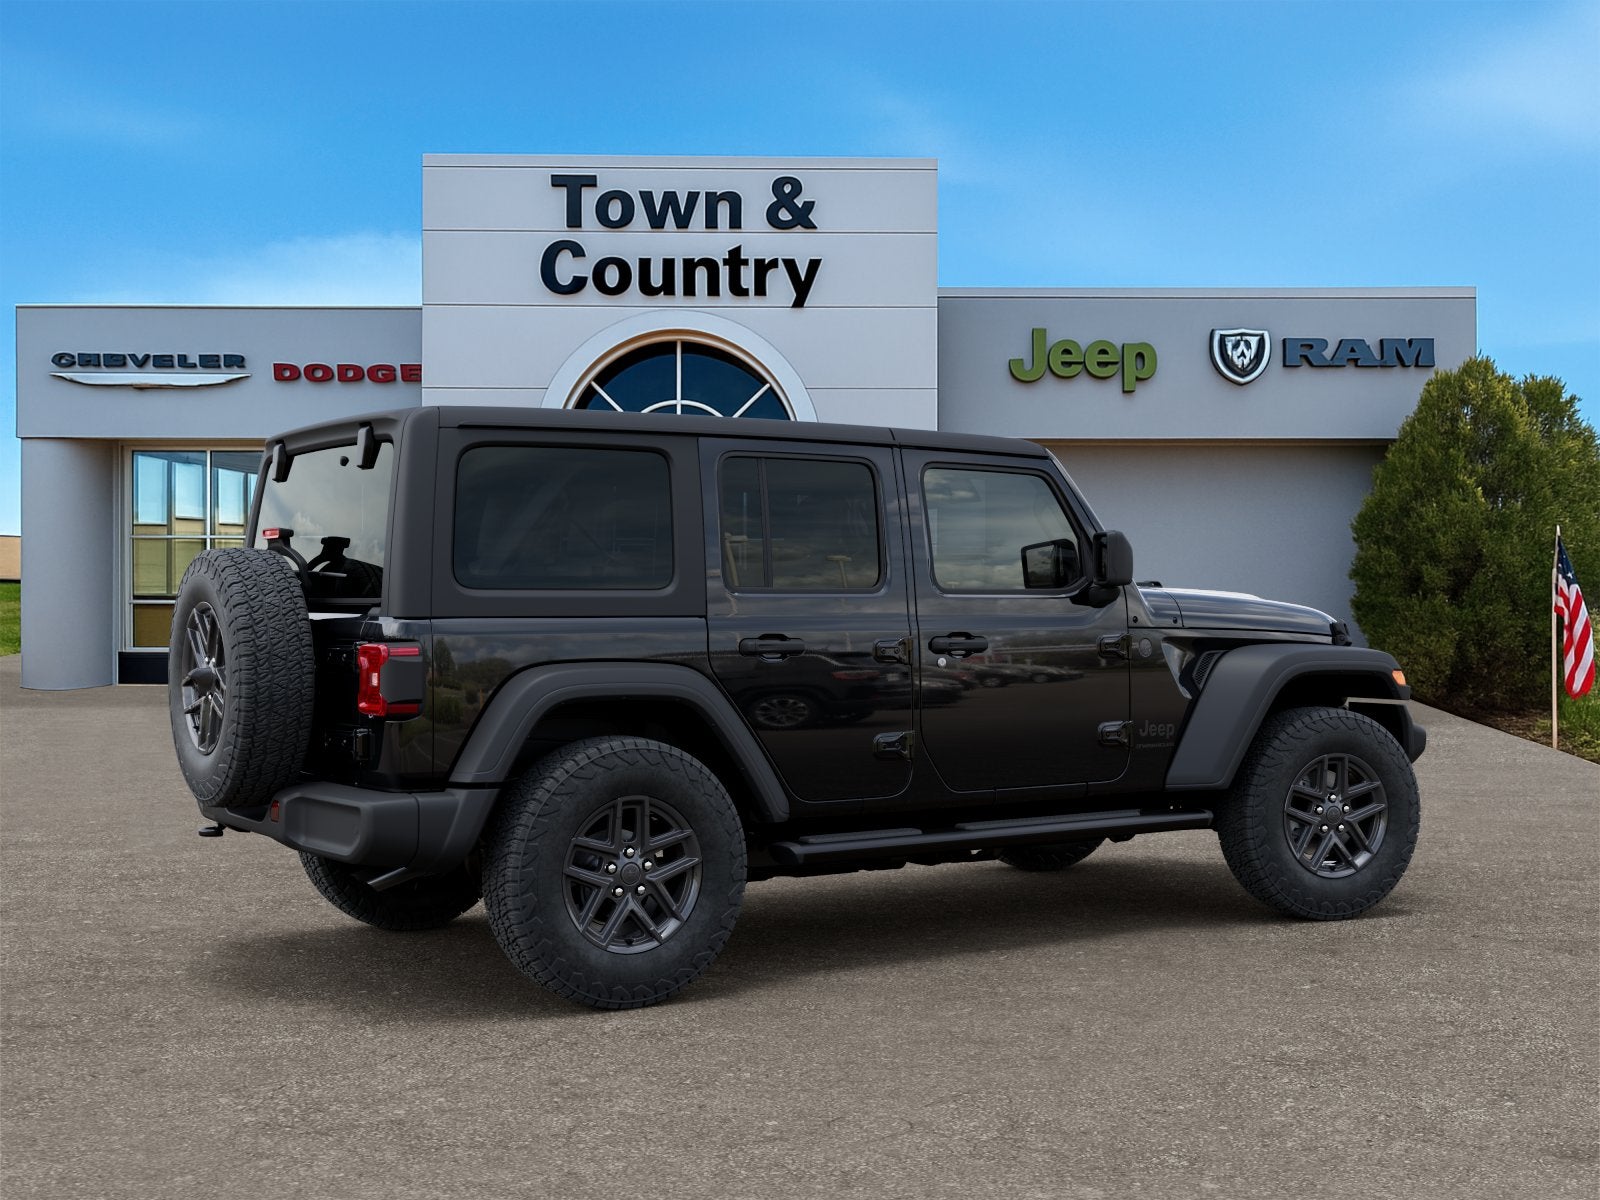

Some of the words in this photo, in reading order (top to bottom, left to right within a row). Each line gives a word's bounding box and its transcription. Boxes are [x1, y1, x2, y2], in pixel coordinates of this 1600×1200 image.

[550, 174, 742, 229] Town
[765, 176, 818, 230] &
[539, 239, 822, 308] Country
[272, 362, 422, 383] DODGE
[1008, 327, 1158, 393] Jeep
[1282, 337, 1435, 368] RAM
[1138, 720, 1175, 739] Jeep
